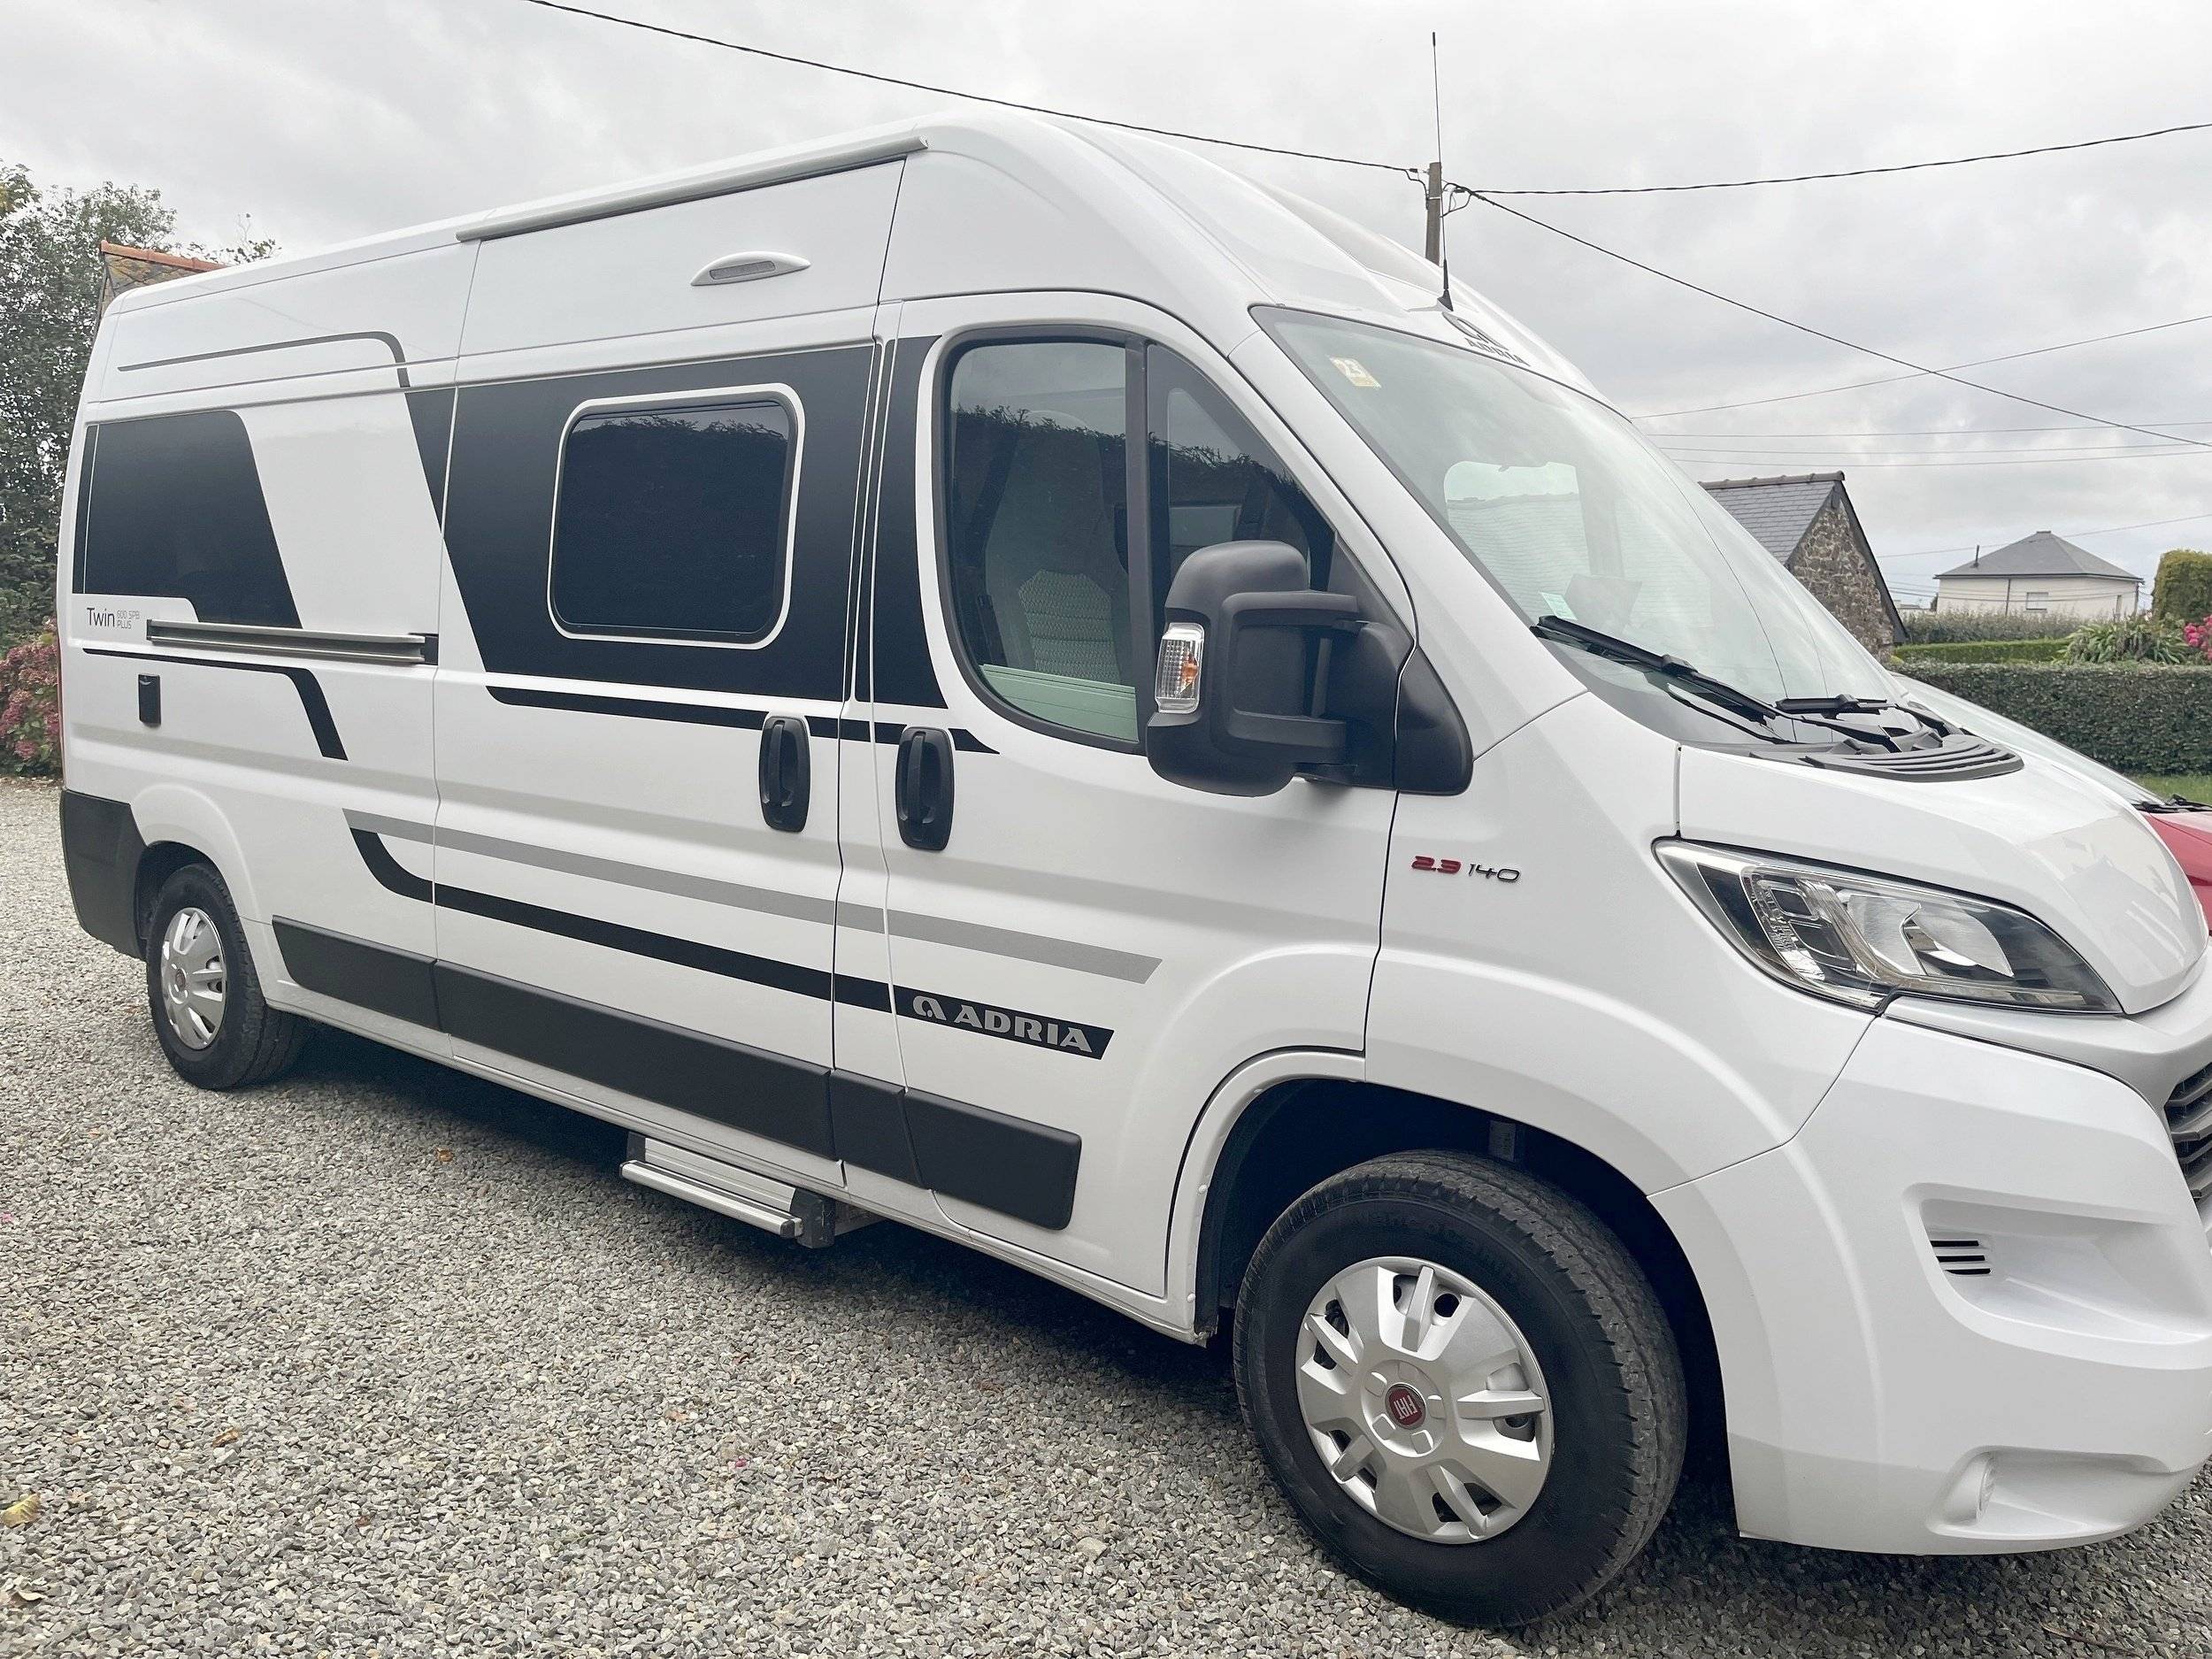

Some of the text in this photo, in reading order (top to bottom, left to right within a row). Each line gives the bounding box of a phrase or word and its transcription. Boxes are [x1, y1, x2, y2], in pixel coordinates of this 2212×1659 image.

[87, 607, 115, 628] Twin
[117, 619, 132, 629] PLUS
[1411, 855, 1520, 883] 2.3 140
[954, 1004, 1093, 1053] ADRIA
[1393, 1394, 1418, 1420] FIAT
